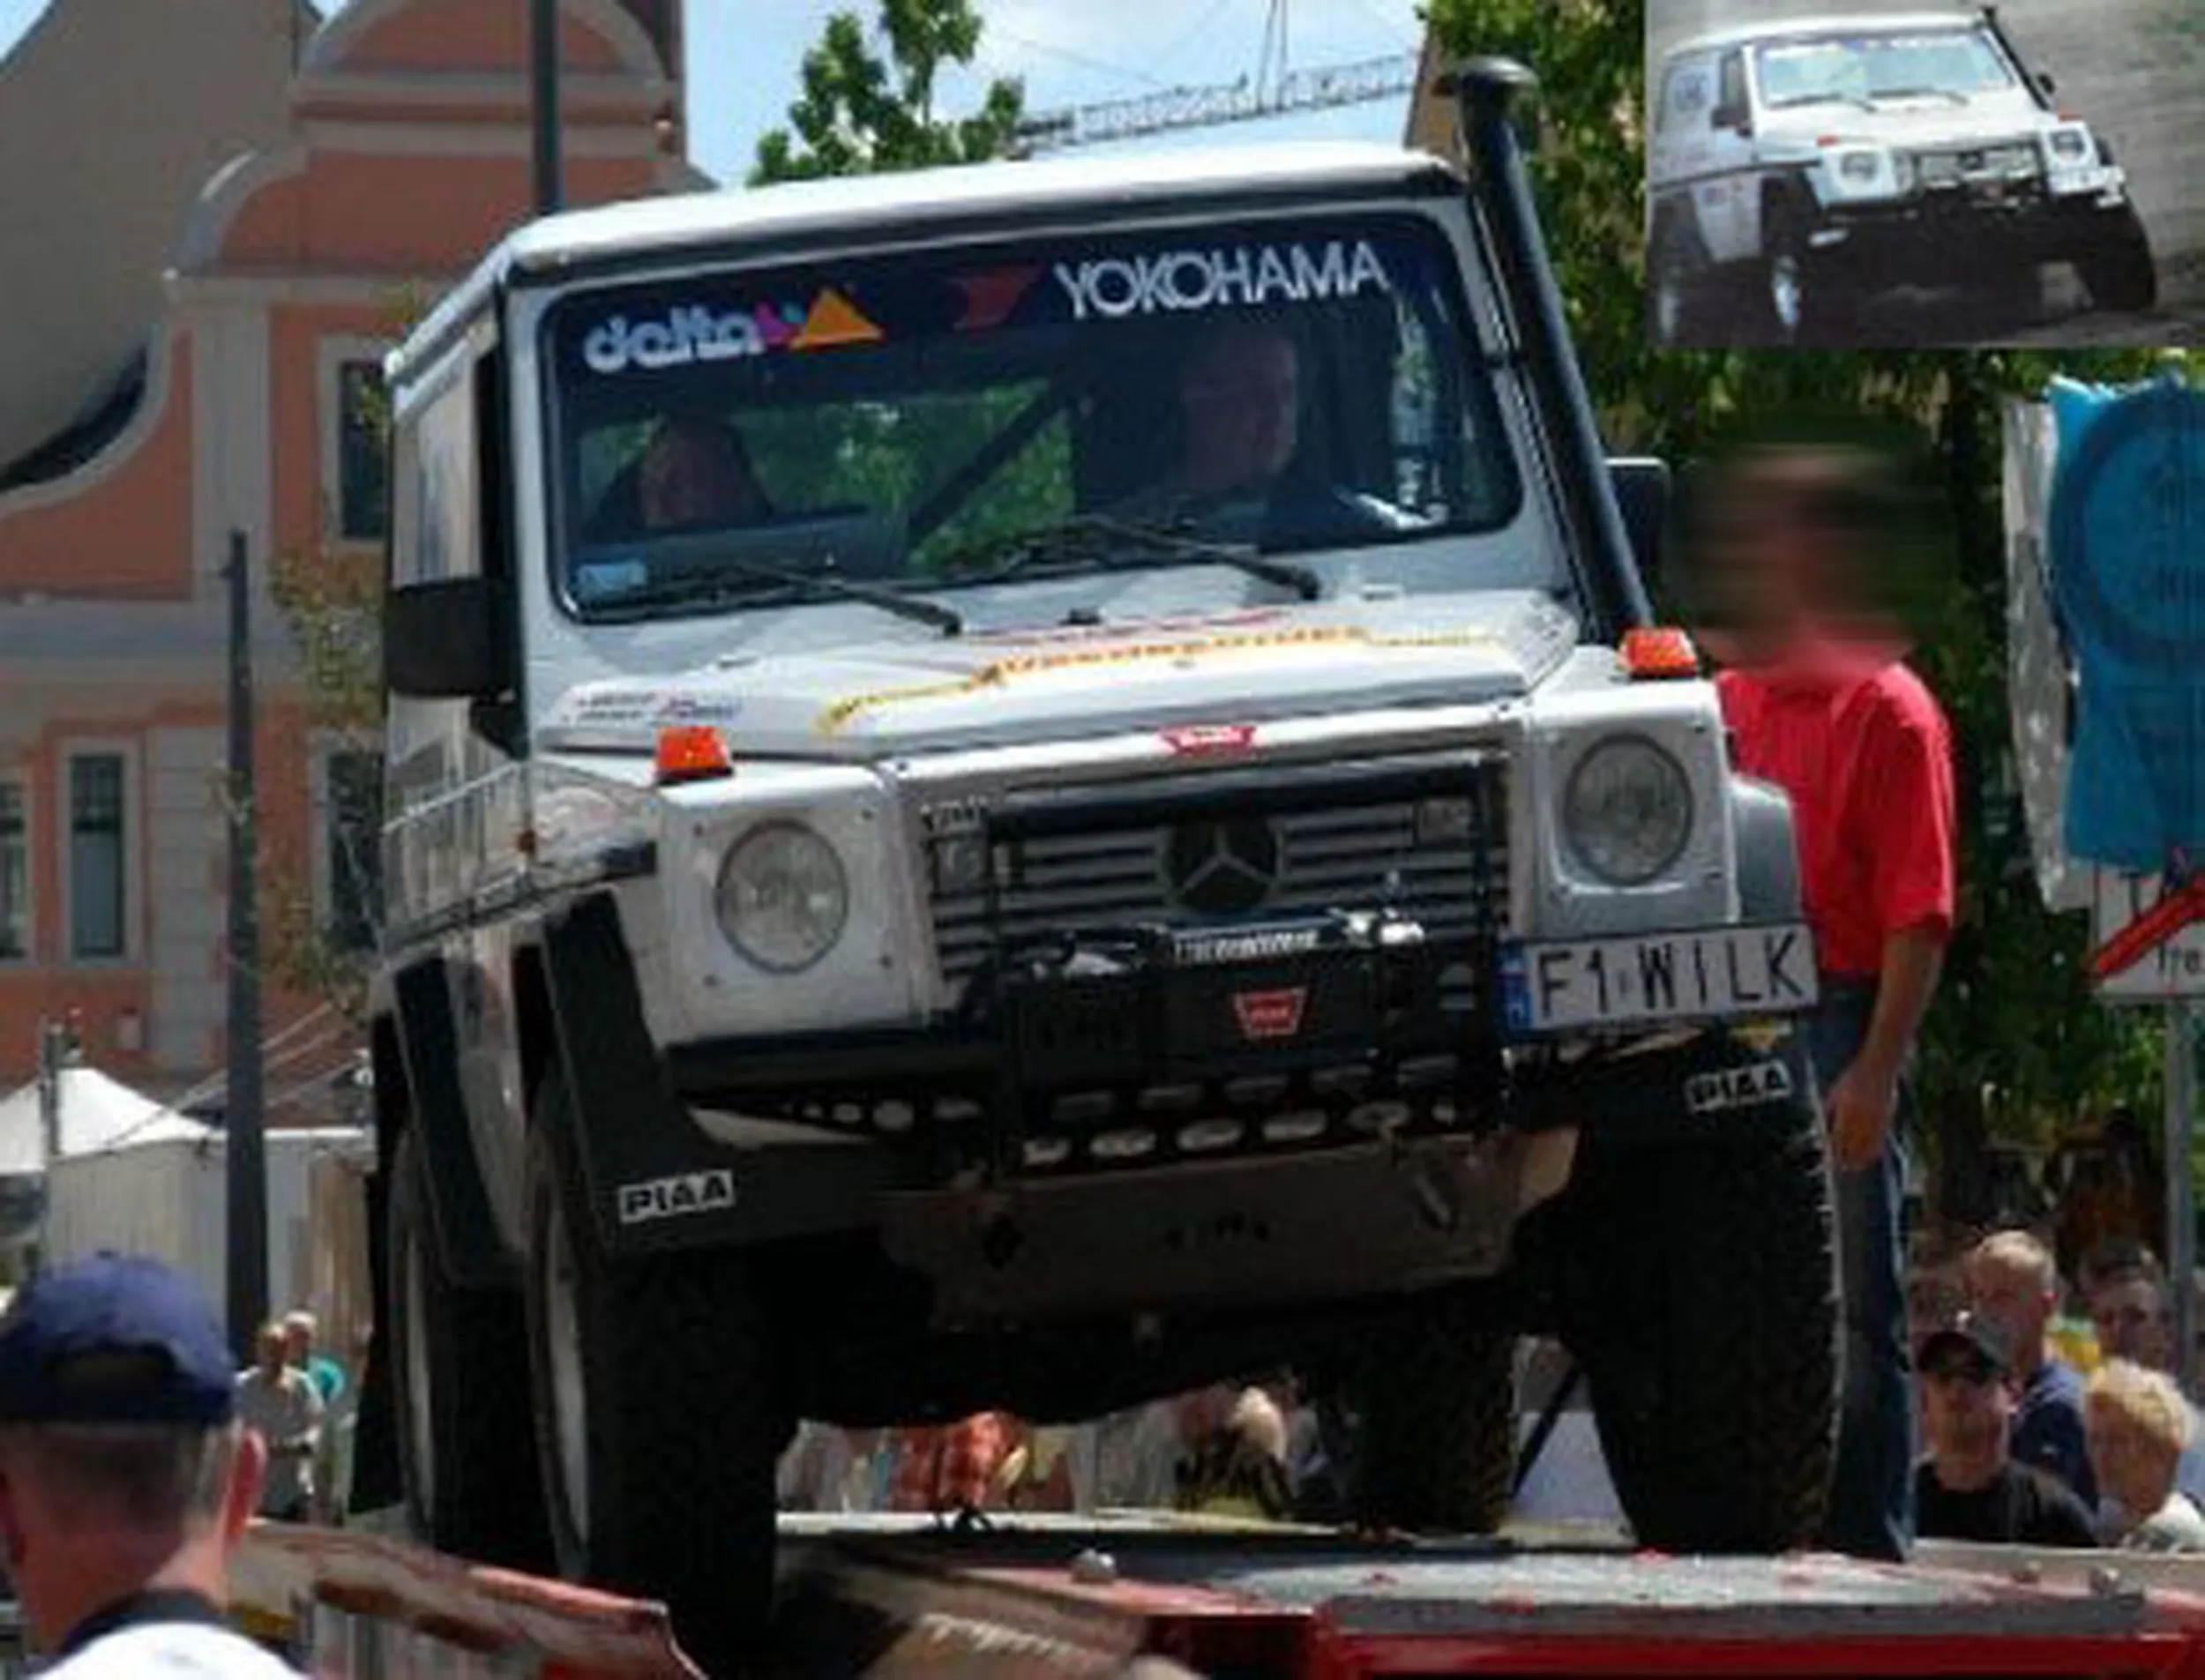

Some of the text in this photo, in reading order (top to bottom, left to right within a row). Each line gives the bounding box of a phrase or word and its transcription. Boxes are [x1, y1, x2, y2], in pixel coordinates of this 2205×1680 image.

[1052, 240, 1391, 319] YOKOHAMA
[584, 304, 766, 373] delta
[1637, 931, 1803, 1011] WILK
[1688, 1064, 1789, 1109] PIAA
[624, 1174, 729, 1216] PIAA
